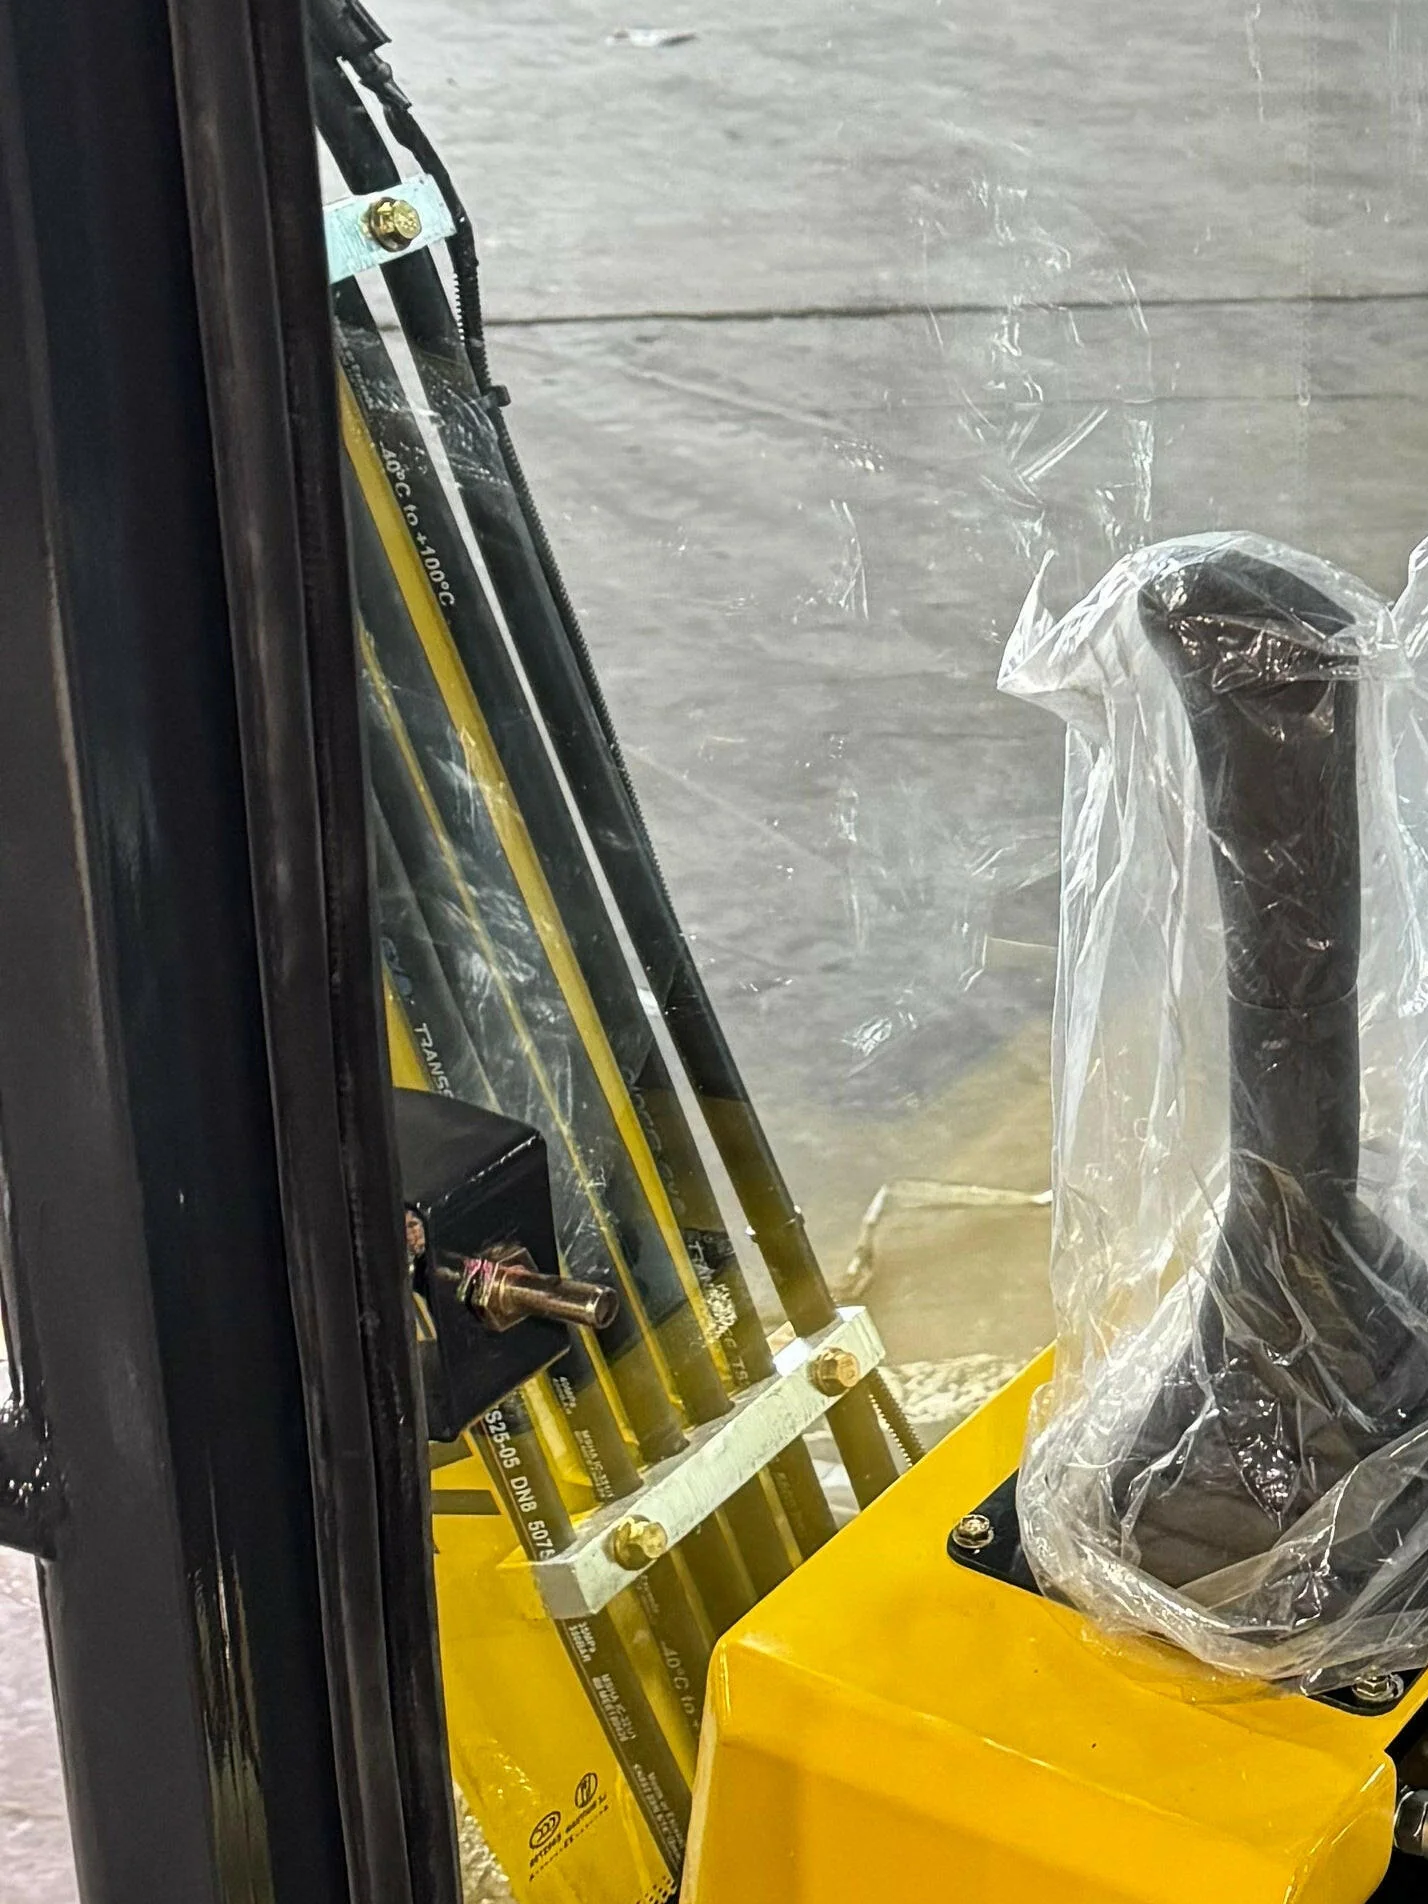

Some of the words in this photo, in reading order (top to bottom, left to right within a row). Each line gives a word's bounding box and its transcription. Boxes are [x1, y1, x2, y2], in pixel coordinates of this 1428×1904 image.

[402, 503, 420, 526] to
[484, 1408, 521, 1470] S25-05
[510, 1474, 537, 1513] DN8
